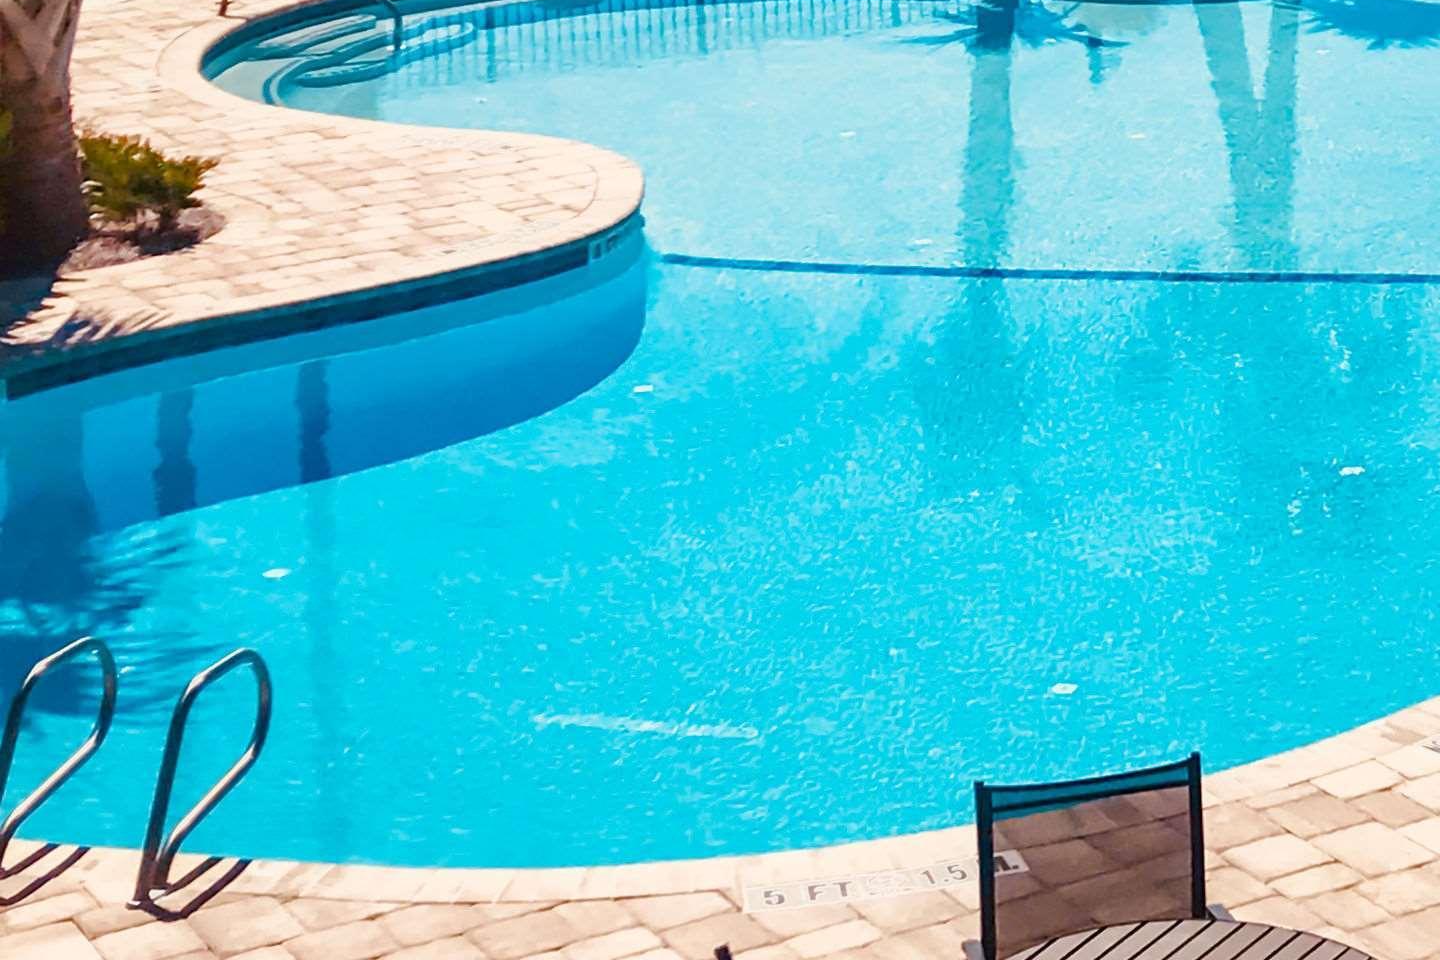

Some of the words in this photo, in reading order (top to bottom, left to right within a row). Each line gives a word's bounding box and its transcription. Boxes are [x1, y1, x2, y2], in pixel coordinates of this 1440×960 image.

[763, 889, 786, 906] 5
[807, 881, 852, 902] FT
[921, 864, 968, 884] 1.5
